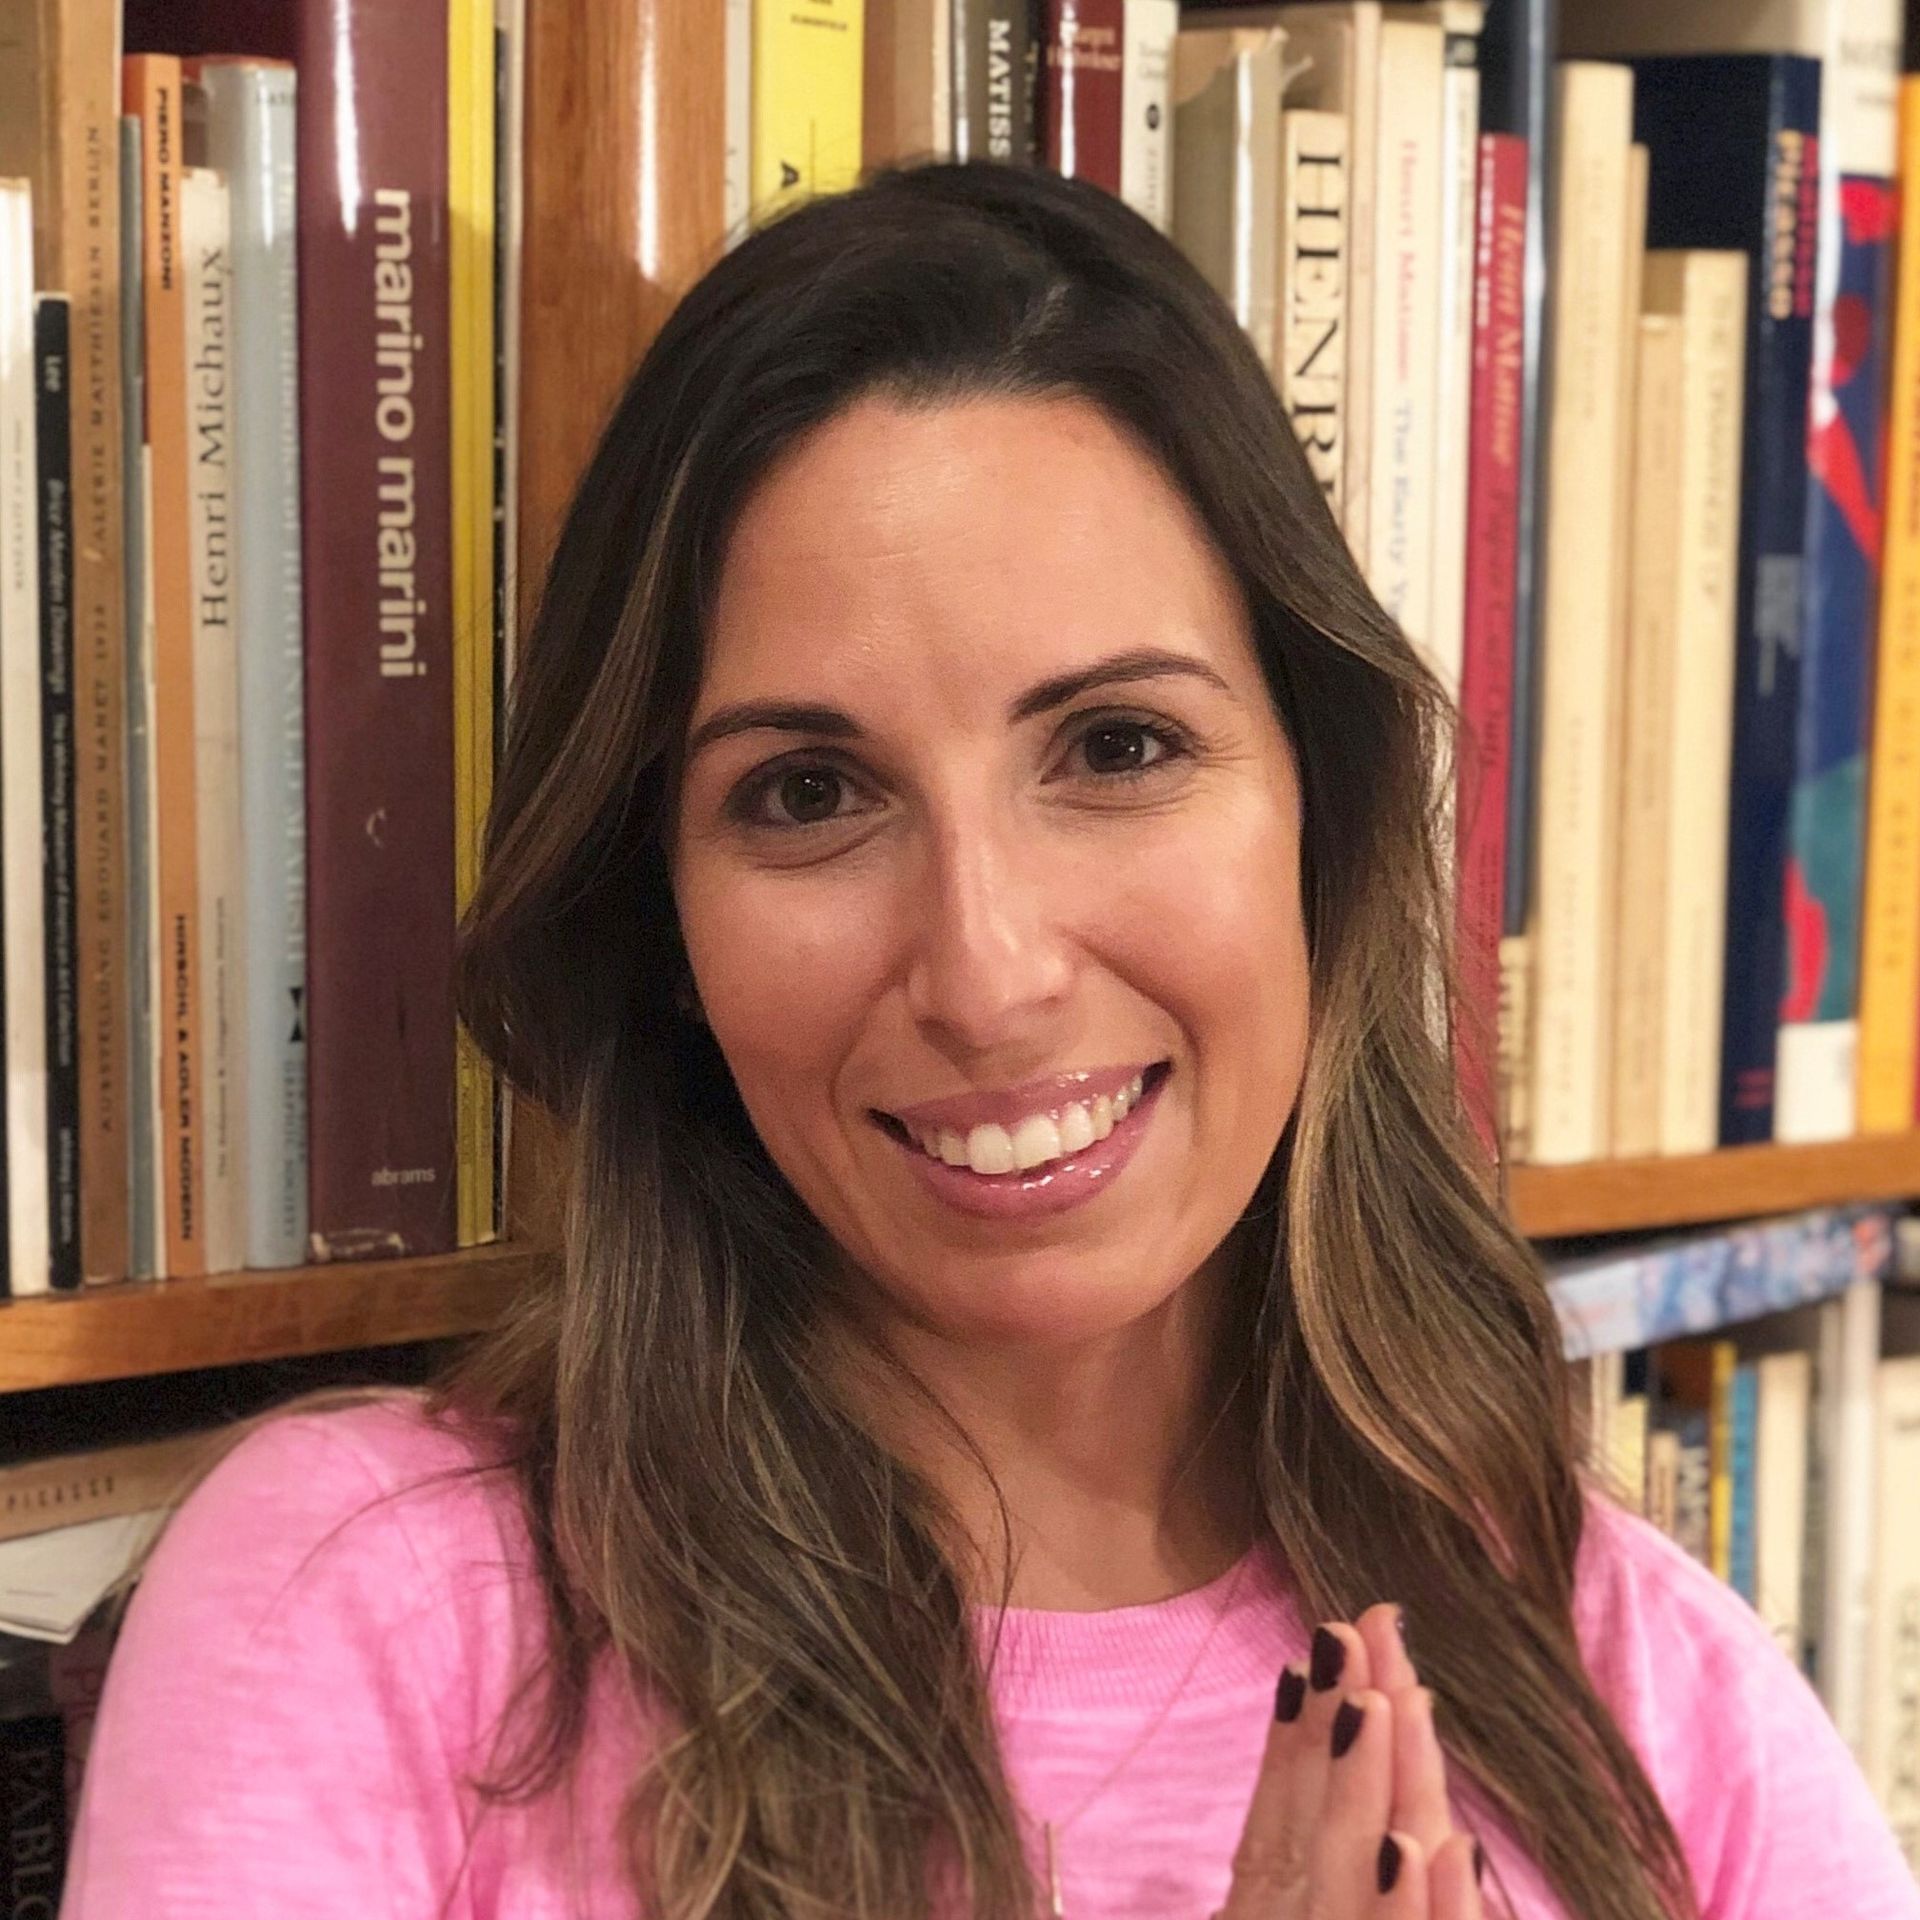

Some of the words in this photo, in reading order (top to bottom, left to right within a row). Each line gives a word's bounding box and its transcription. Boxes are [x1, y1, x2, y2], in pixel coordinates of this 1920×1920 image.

[87, 127, 102, 227] BERLIN
[159, 172, 172, 291] MANZONI
[194, 247, 227, 468] Michaux
[375, 188, 425, 442] marino
[45, 355, 62, 392] Lee
[198, 491, 228, 629] Henri
[379, 456, 428, 677] marini
[181, 1136, 194, 1242] MODERN
[371, 1166, 436, 1187] abrams
[7, 1475, 114, 1513] PICASSO
